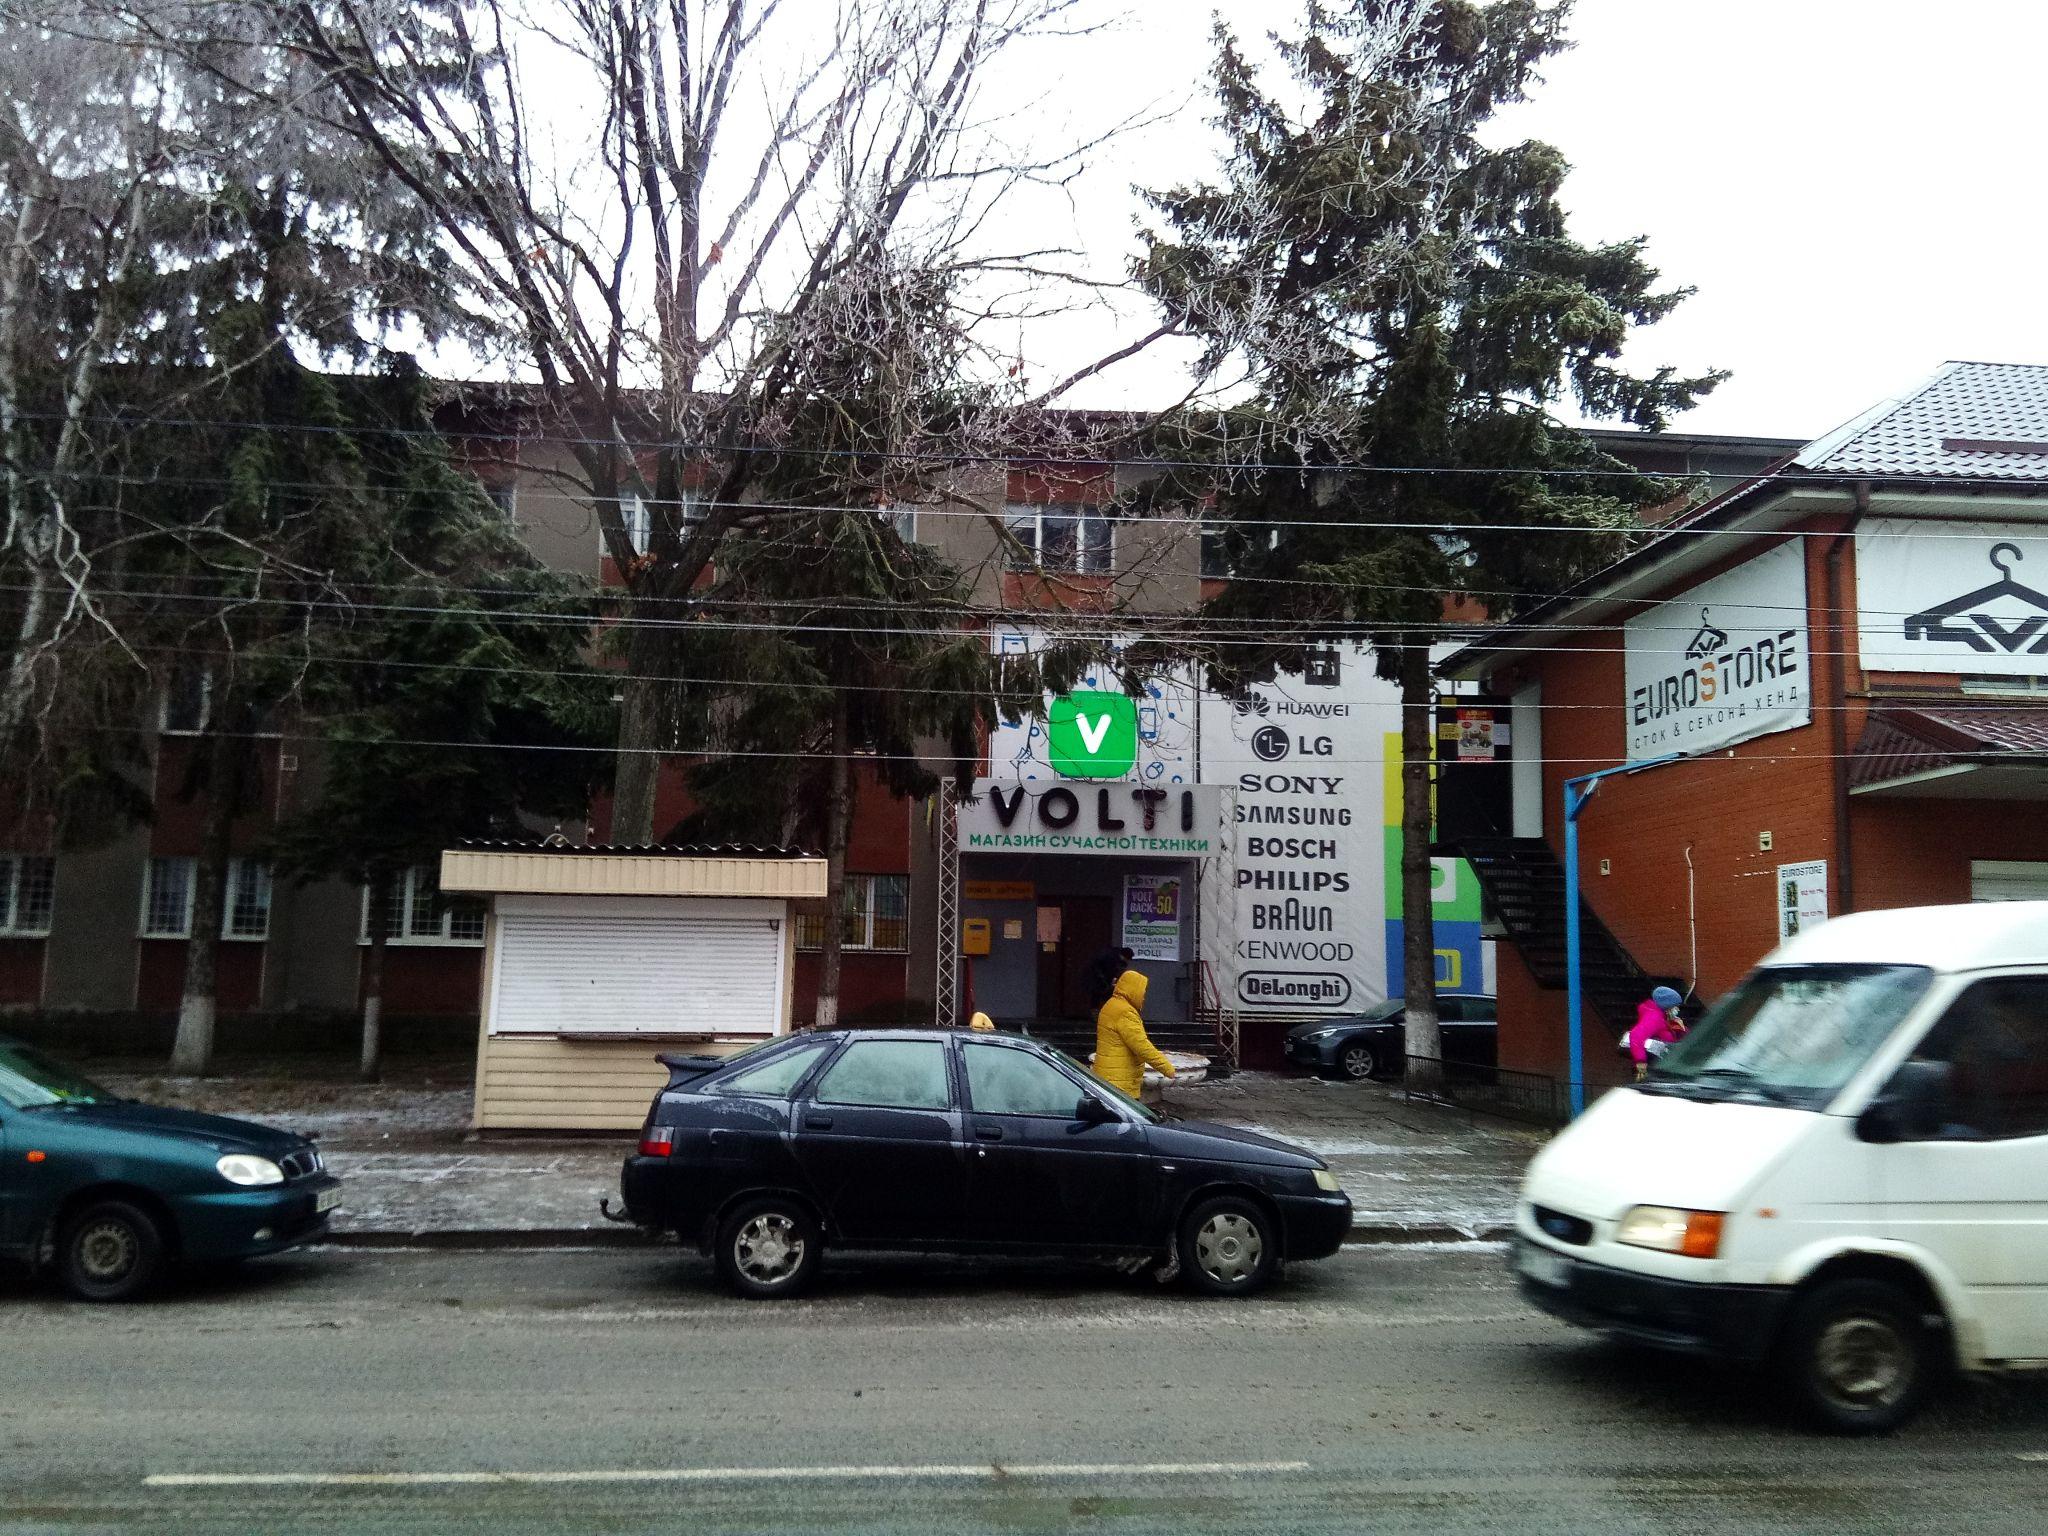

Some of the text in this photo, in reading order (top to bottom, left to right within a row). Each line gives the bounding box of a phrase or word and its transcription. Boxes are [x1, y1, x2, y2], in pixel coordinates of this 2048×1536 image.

[1633, 628, 1797, 726] EUROSTORE
[1276, 701, 1349, 717] HUAWEI
[1634, 686, 1798, 750] СТОК & СЕКОНД ХЕНД
[1075, 712, 1112, 754] V
[1298, 736, 1333, 756] LG
[1239, 774, 1344, 795] SONY
[989, 785, 1193, 832] VOLTI
[1236, 804, 1352, 827] SAMSUNG
[969, 833, 1046, 849] МАГАЗИН
[1049, 834, 1137, 850] СУЧАСНОЇ
[1247, 837, 1336, 860] BOSCH
[1237, 869, 1350, 892] PHILIPS
[1781, 865, 1824, 878] EUROSTORE
[1252, 897, 1333, 931] BRAUN
